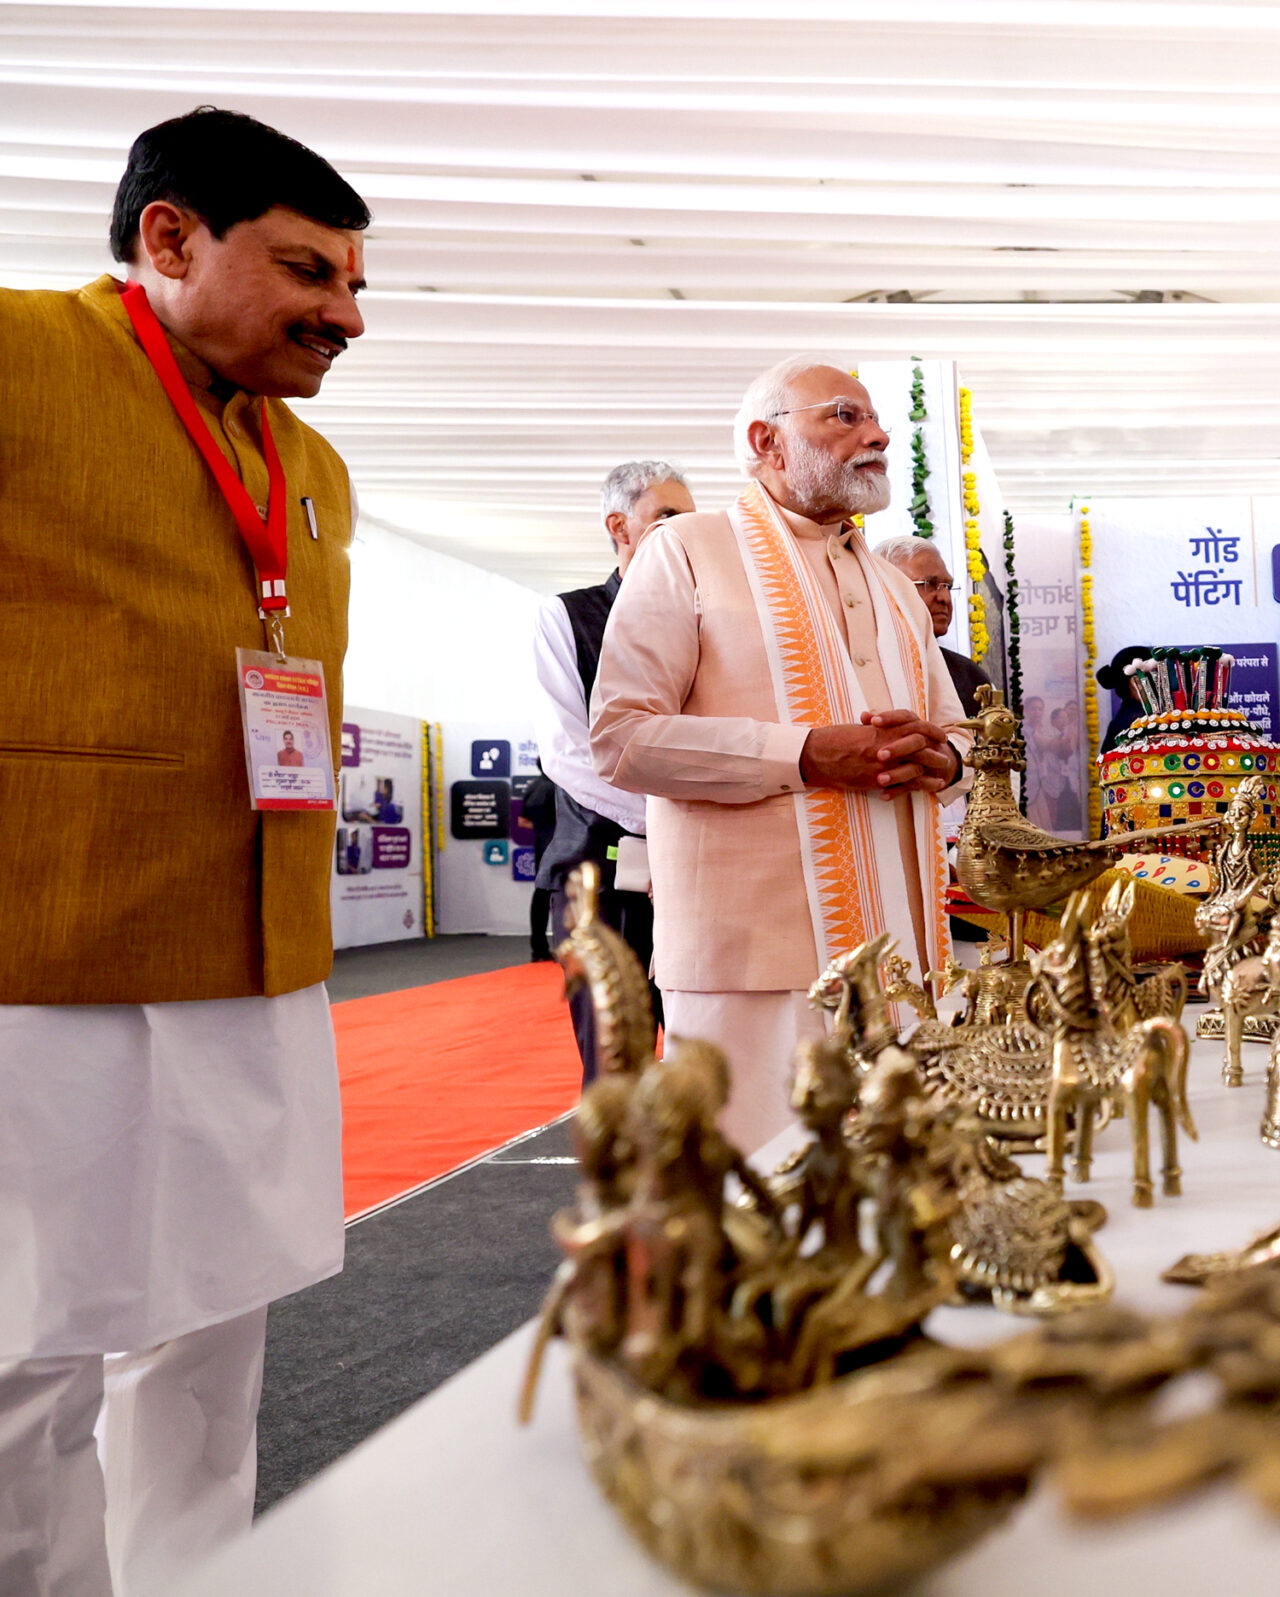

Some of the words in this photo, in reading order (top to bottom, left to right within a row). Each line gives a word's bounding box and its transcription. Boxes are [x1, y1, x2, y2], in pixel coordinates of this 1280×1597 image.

[1189, 527, 1240, 563] गोंड
[1170, 568, 1243, 607] पेंटिंग
[1260, 655, 1269, 667] से
